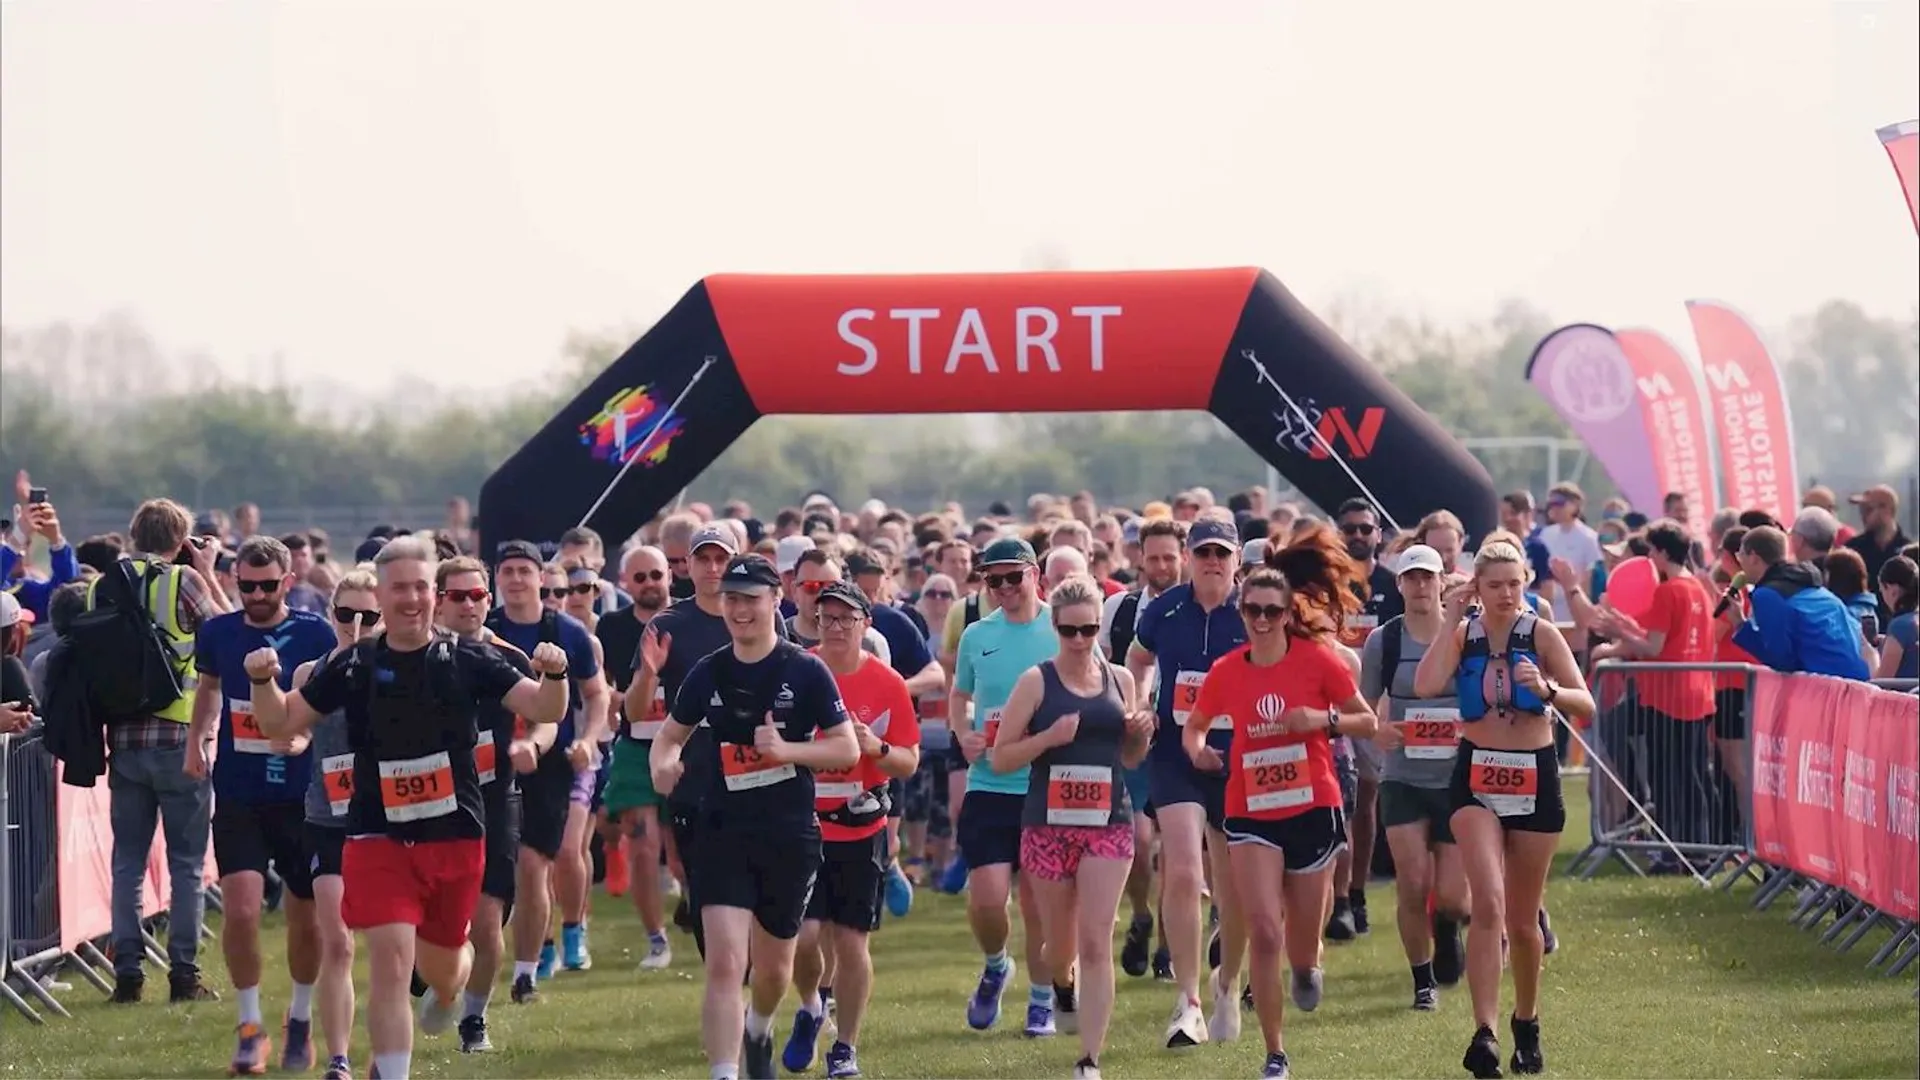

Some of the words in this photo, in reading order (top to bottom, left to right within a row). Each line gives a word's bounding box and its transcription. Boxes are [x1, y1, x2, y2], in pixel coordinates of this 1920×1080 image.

[836, 306, 1122, 376] START
[1415, 722, 1455, 738] 222
[395, 773, 439, 798] 591
[1255, 762, 1298, 786] 238
[1482, 766, 1525, 788] 265
[1060, 782, 1102, 801] 388
